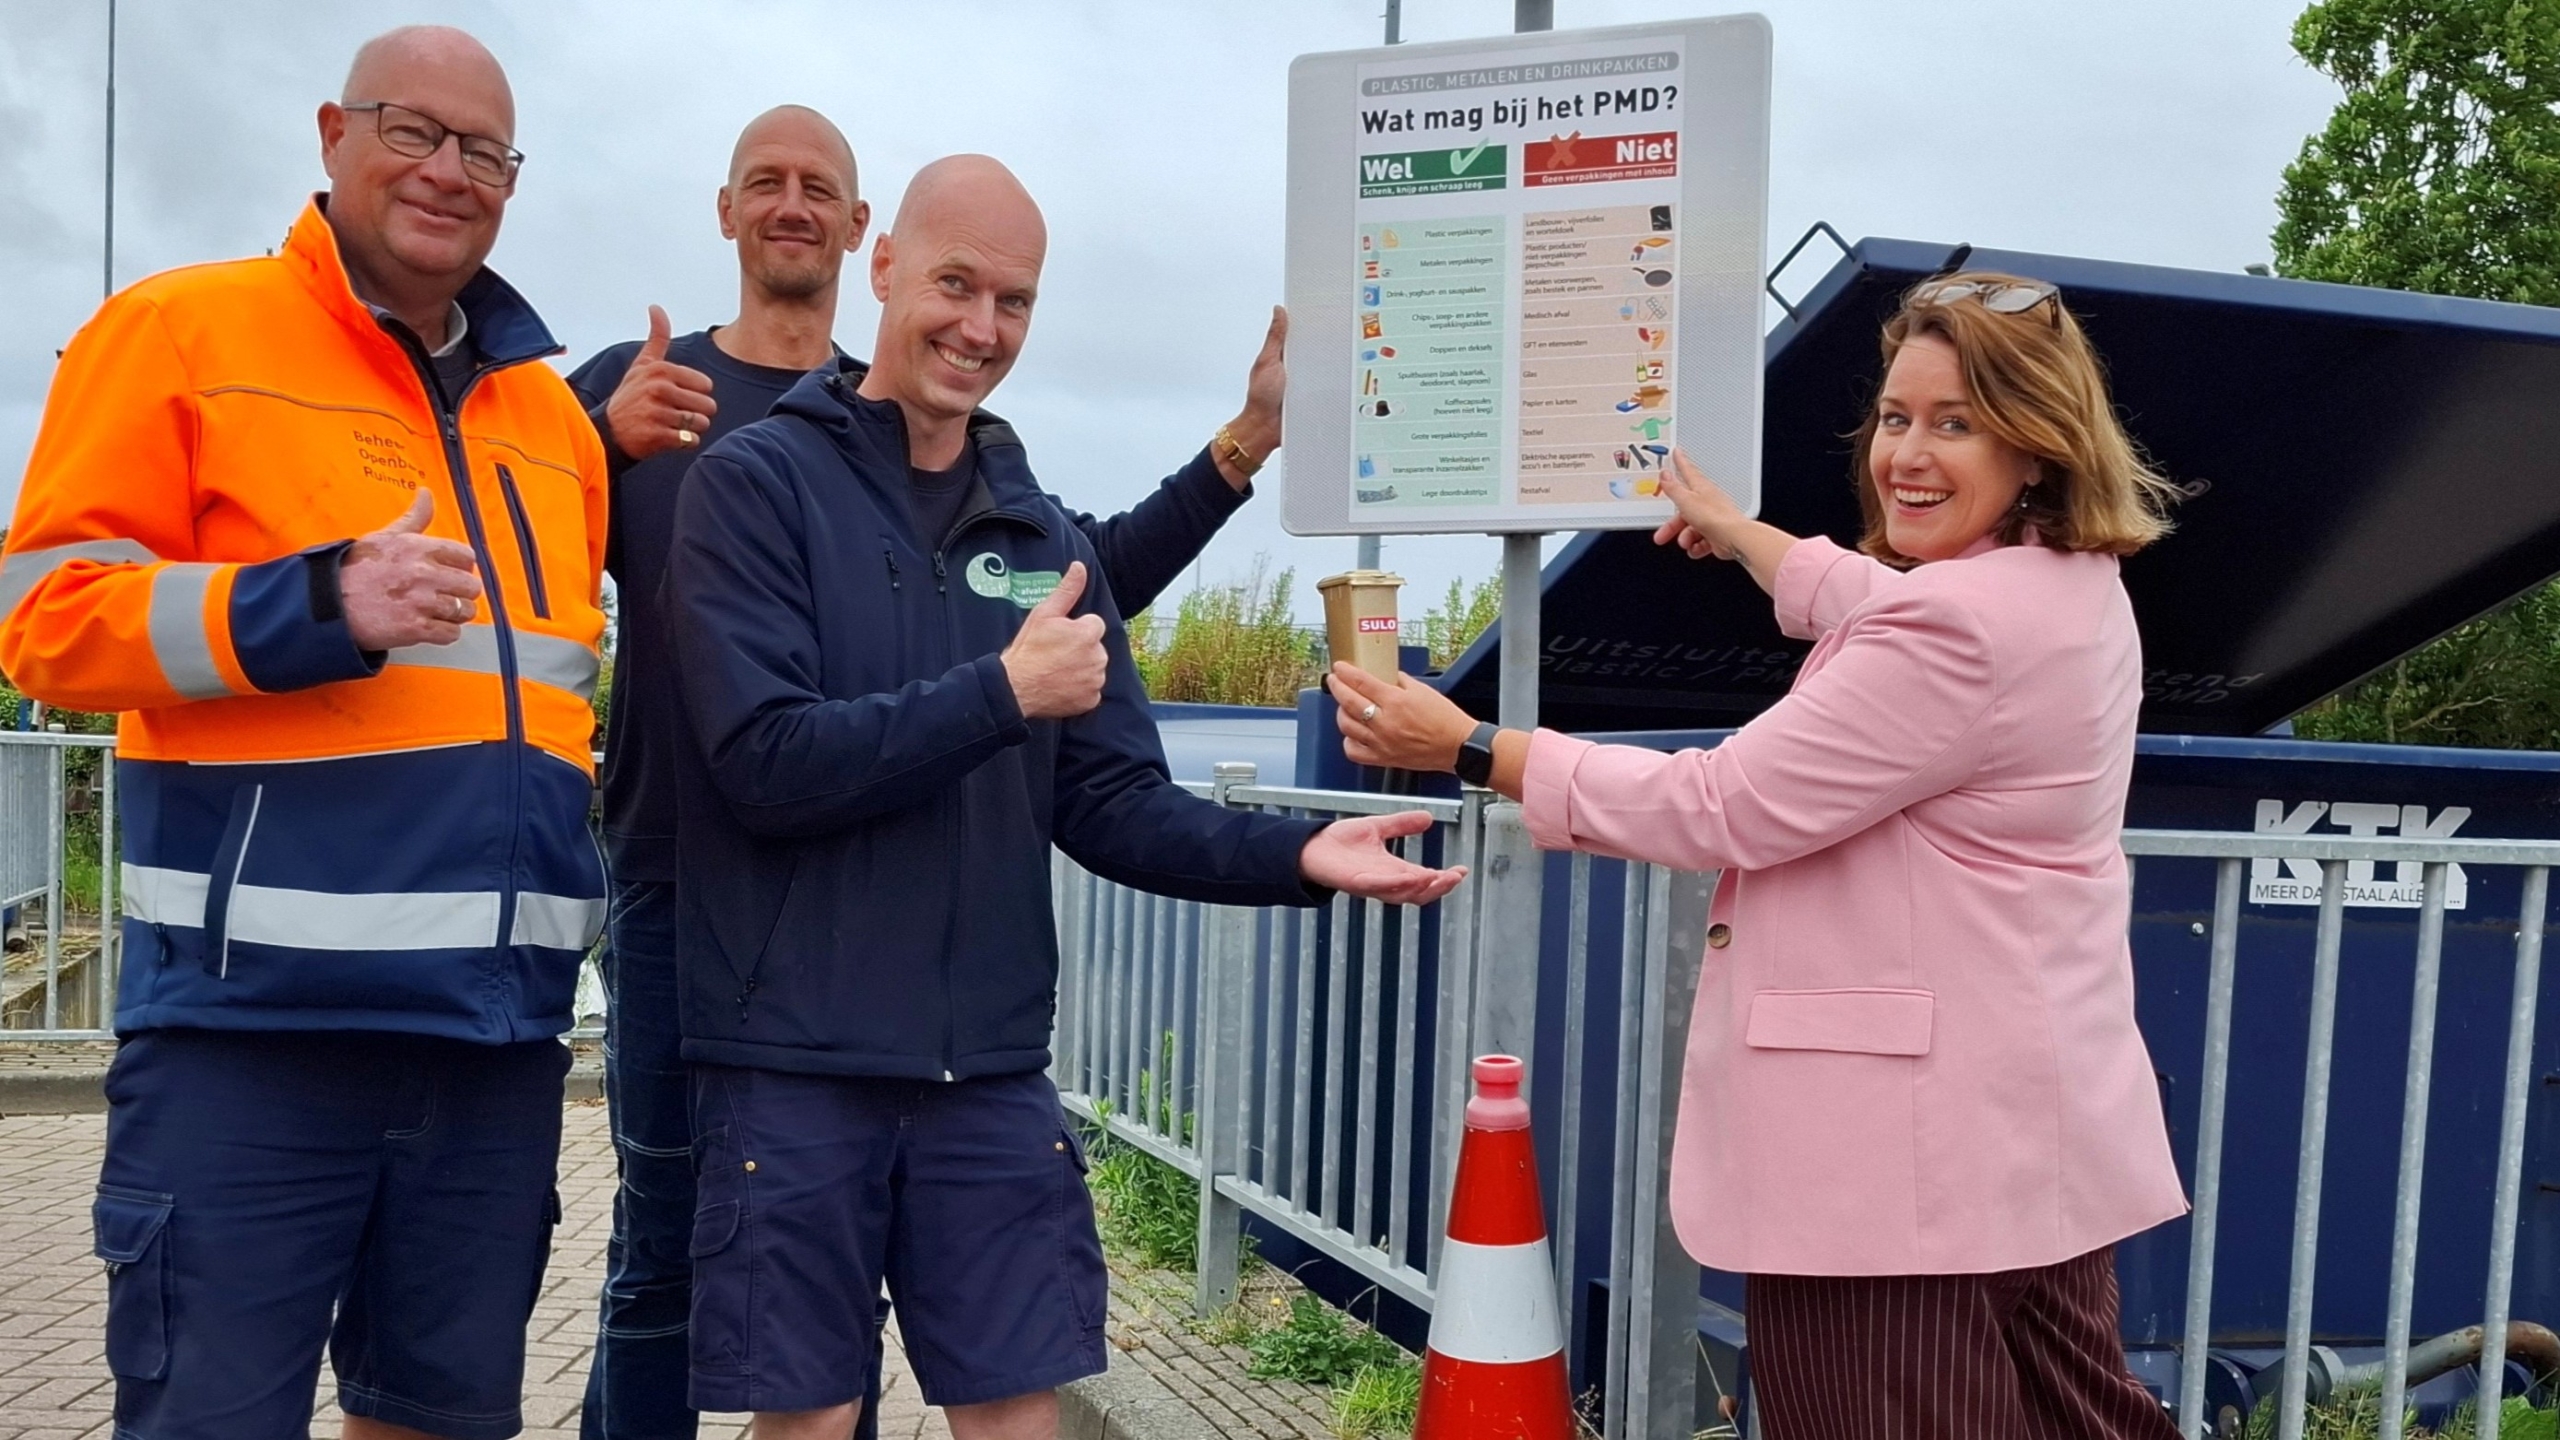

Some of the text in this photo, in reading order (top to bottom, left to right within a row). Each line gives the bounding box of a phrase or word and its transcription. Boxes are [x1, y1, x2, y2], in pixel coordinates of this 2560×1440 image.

[1371, 55, 1669, 93] PLASTIC, METALEN EN DRINKPAKKEN
[1361, 85, 1678, 134] Wat mag bij het PMD?
[1616, 138, 1673, 163] Niet
[1363, 157, 1414, 181] Wel
[1542, 166, 1674, 184] Geen verpakkingen met inhoud
[1363, 181, 1483, 196] Schenk, knijp en schraap leeg
[1424, 227, 1493, 238] Plastic verpakkingen
[1525, 243, 1547, 251] Plastic
[1420, 257, 1493, 267] Metalen verpakkingen
[1524, 278, 1552, 286] Metalen
[1524, 286, 1542, 295] zoals
[1543, 285, 1565, 294] bestek
[1576, 284, 1604, 293] pannen
[1465, 310, 1489, 318] andere
[1524, 309, 1570, 319] Medisch afval
[1429, 346, 1457, 354] Doppen
[1467, 343, 1493, 352] deksels
[1523, 341, 1537, 349] GFT
[1522, 370, 1538, 379] Glas
[1522, 399, 1544, 408] Papier
[1555, 398, 1578, 406] karton
[1461, 406, 1475, 414] niet
[1411, 432, 1430, 440] Grote
[1521, 428, 1544, 436] Textiel
[1521, 452, 1557, 461] Elektrische
[1552, 461, 1586, 470] batterijen
[363, 466, 417, 491] Ruimte
[1421, 489, 1438, 498] Lege
[1520, 486, 1551, 494] Restafval
[1361, 619, 1396, 631] SULO
[2251, 799, 2472, 883] KTK
[2255, 884, 2298, 900] MEER
